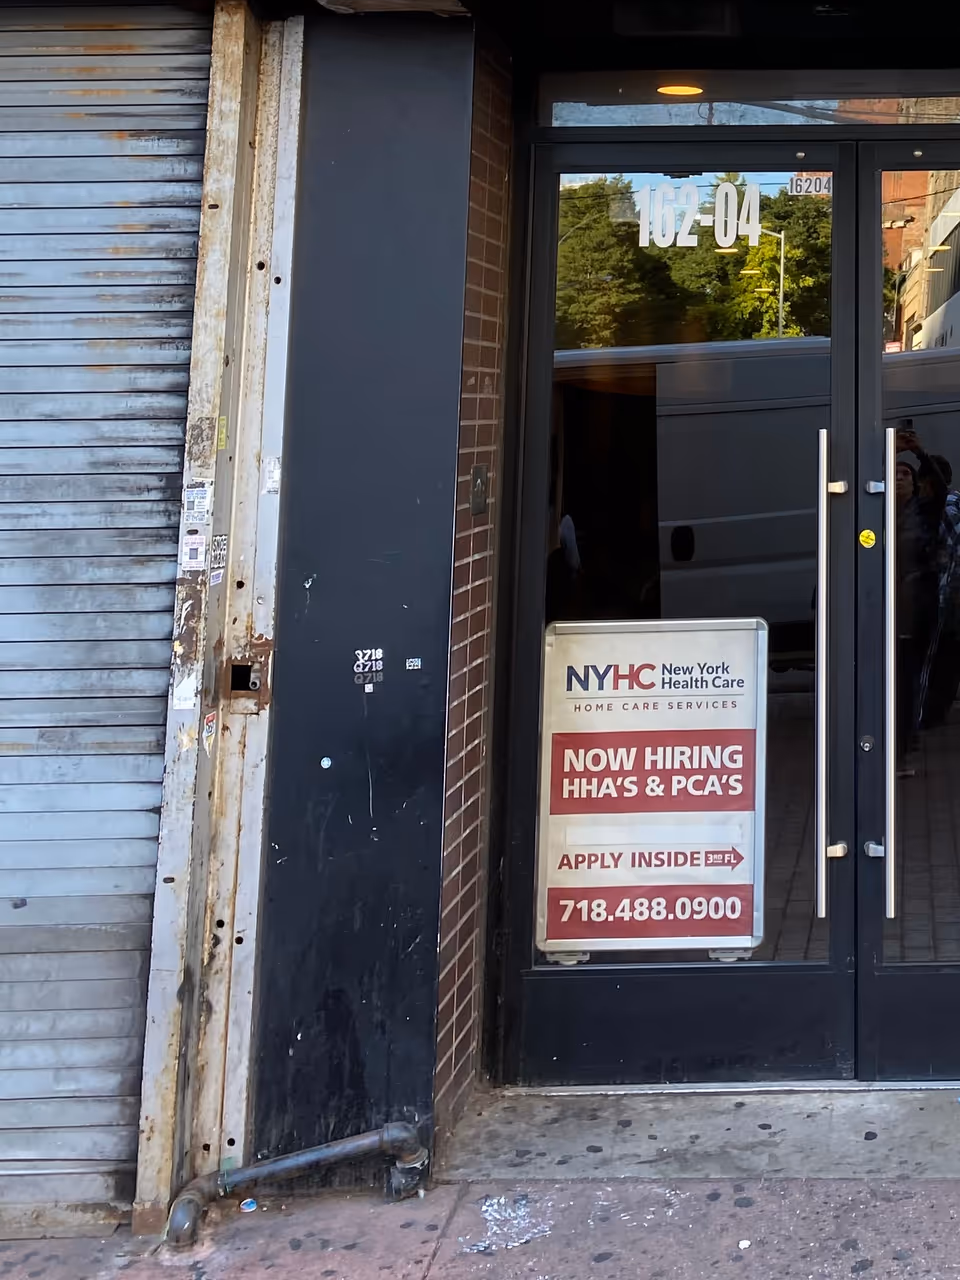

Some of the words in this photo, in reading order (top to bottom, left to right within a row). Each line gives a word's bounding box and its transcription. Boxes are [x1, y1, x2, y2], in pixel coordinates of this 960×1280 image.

[789, 176, 832, 194] 16204
[634, 182, 762, 248] 162-04
[566, 663, 656, 692] NYHC
[661, 663, 693, 676] New
[697, 662, 730, 675] York
[661, 676, 709, 690] Health
[711, 676, 745, 689] Care
[574, 703, 614, 712] HOME
[622, 702, 659, 711] CARE
[667, 700, 738, 710] SERVICES
[563, 748, 637, 772] NOW
[644, 745, 743, 770] HIRING
[562, 776, 638, 798] HHA'S
[644, 776, 665, 797] &
[671, 775, 743, 796] PCA'S
[558, 852, 623, 870] APPLY
[631, 851, 701, 868] INSIDE
[724, 853, 737, 864] FL
[559, 896, 742, 922] 718.488.0900
